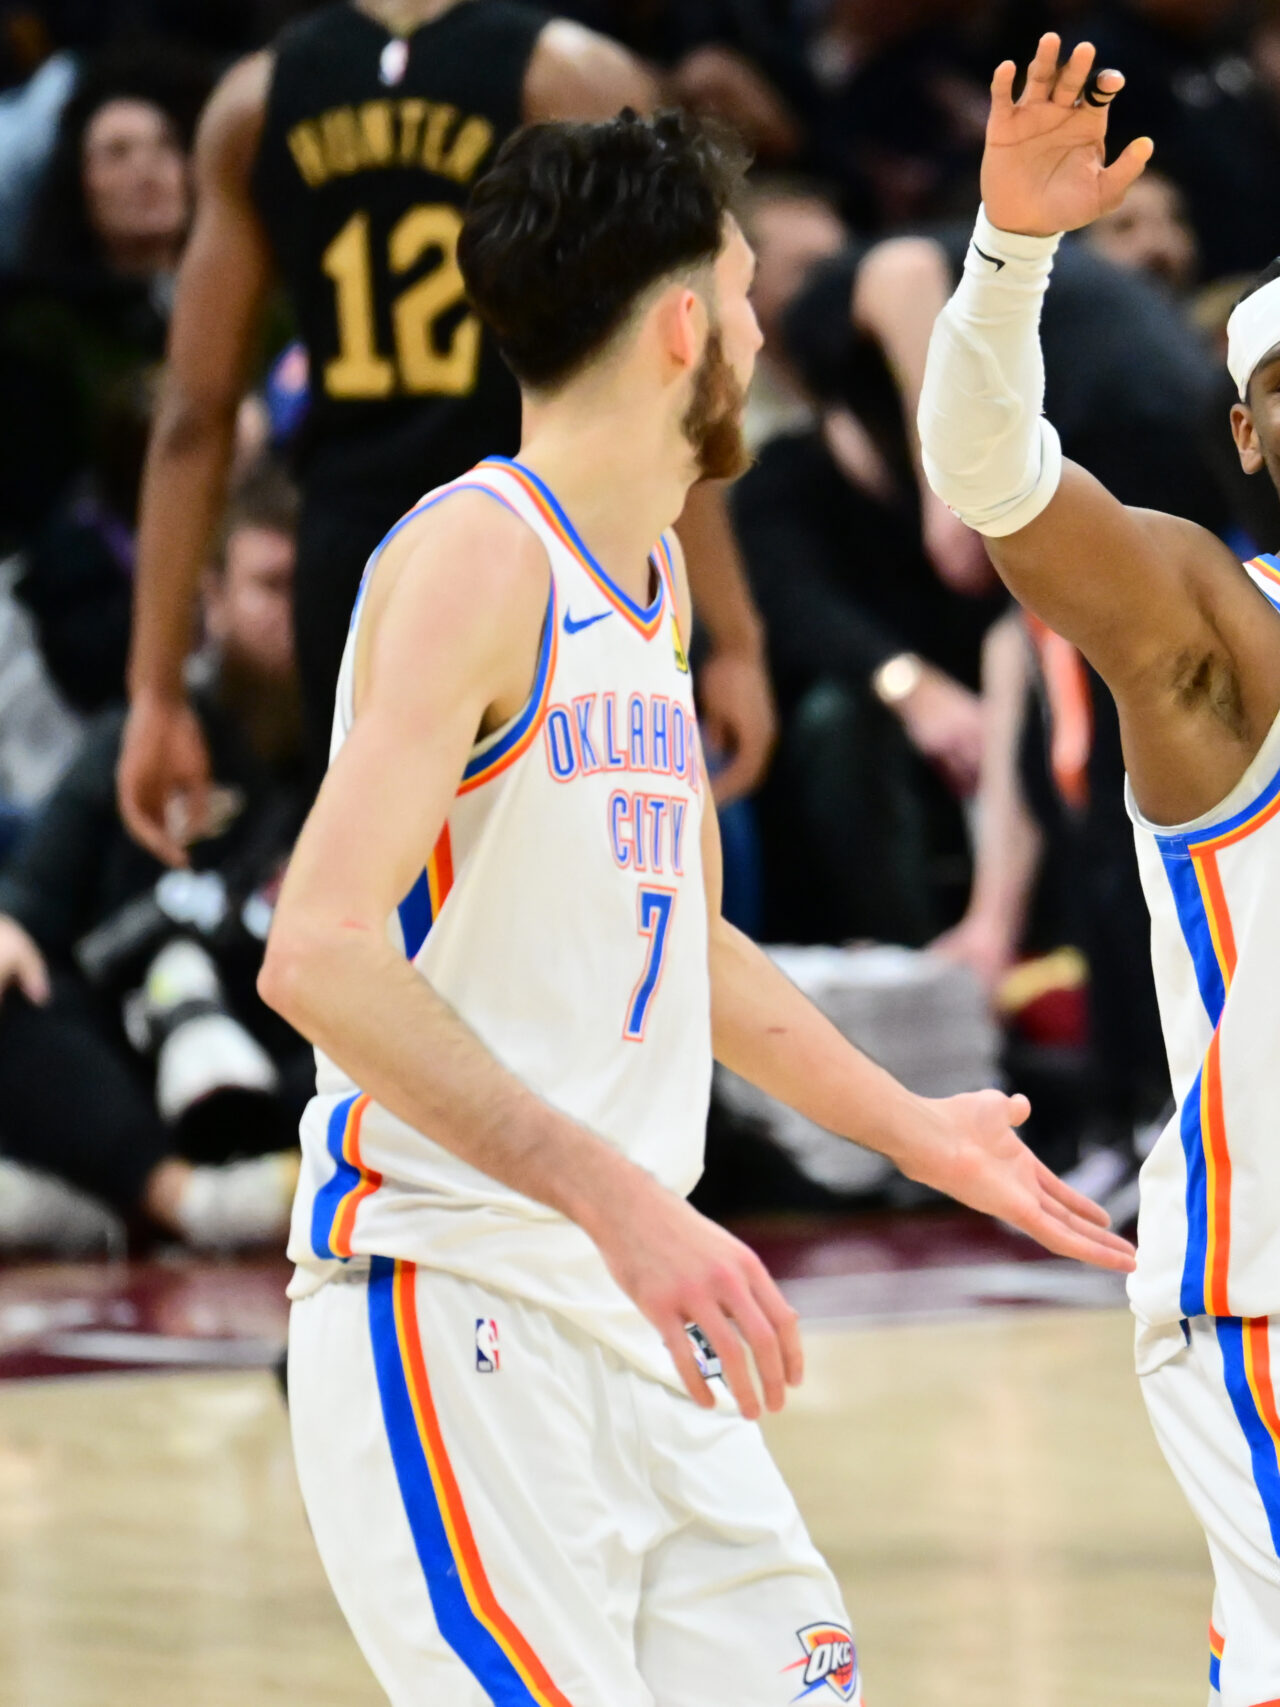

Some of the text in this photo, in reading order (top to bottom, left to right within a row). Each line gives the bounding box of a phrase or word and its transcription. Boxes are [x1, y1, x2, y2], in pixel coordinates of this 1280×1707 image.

[286, 99, 494, 189] HUNTER
[322, 202, 482, 398] 12
[608, 789, 688, 876] CITY
[622, 884, 678, 1043] 7
[803, 1640, 852, 1686] OKC
